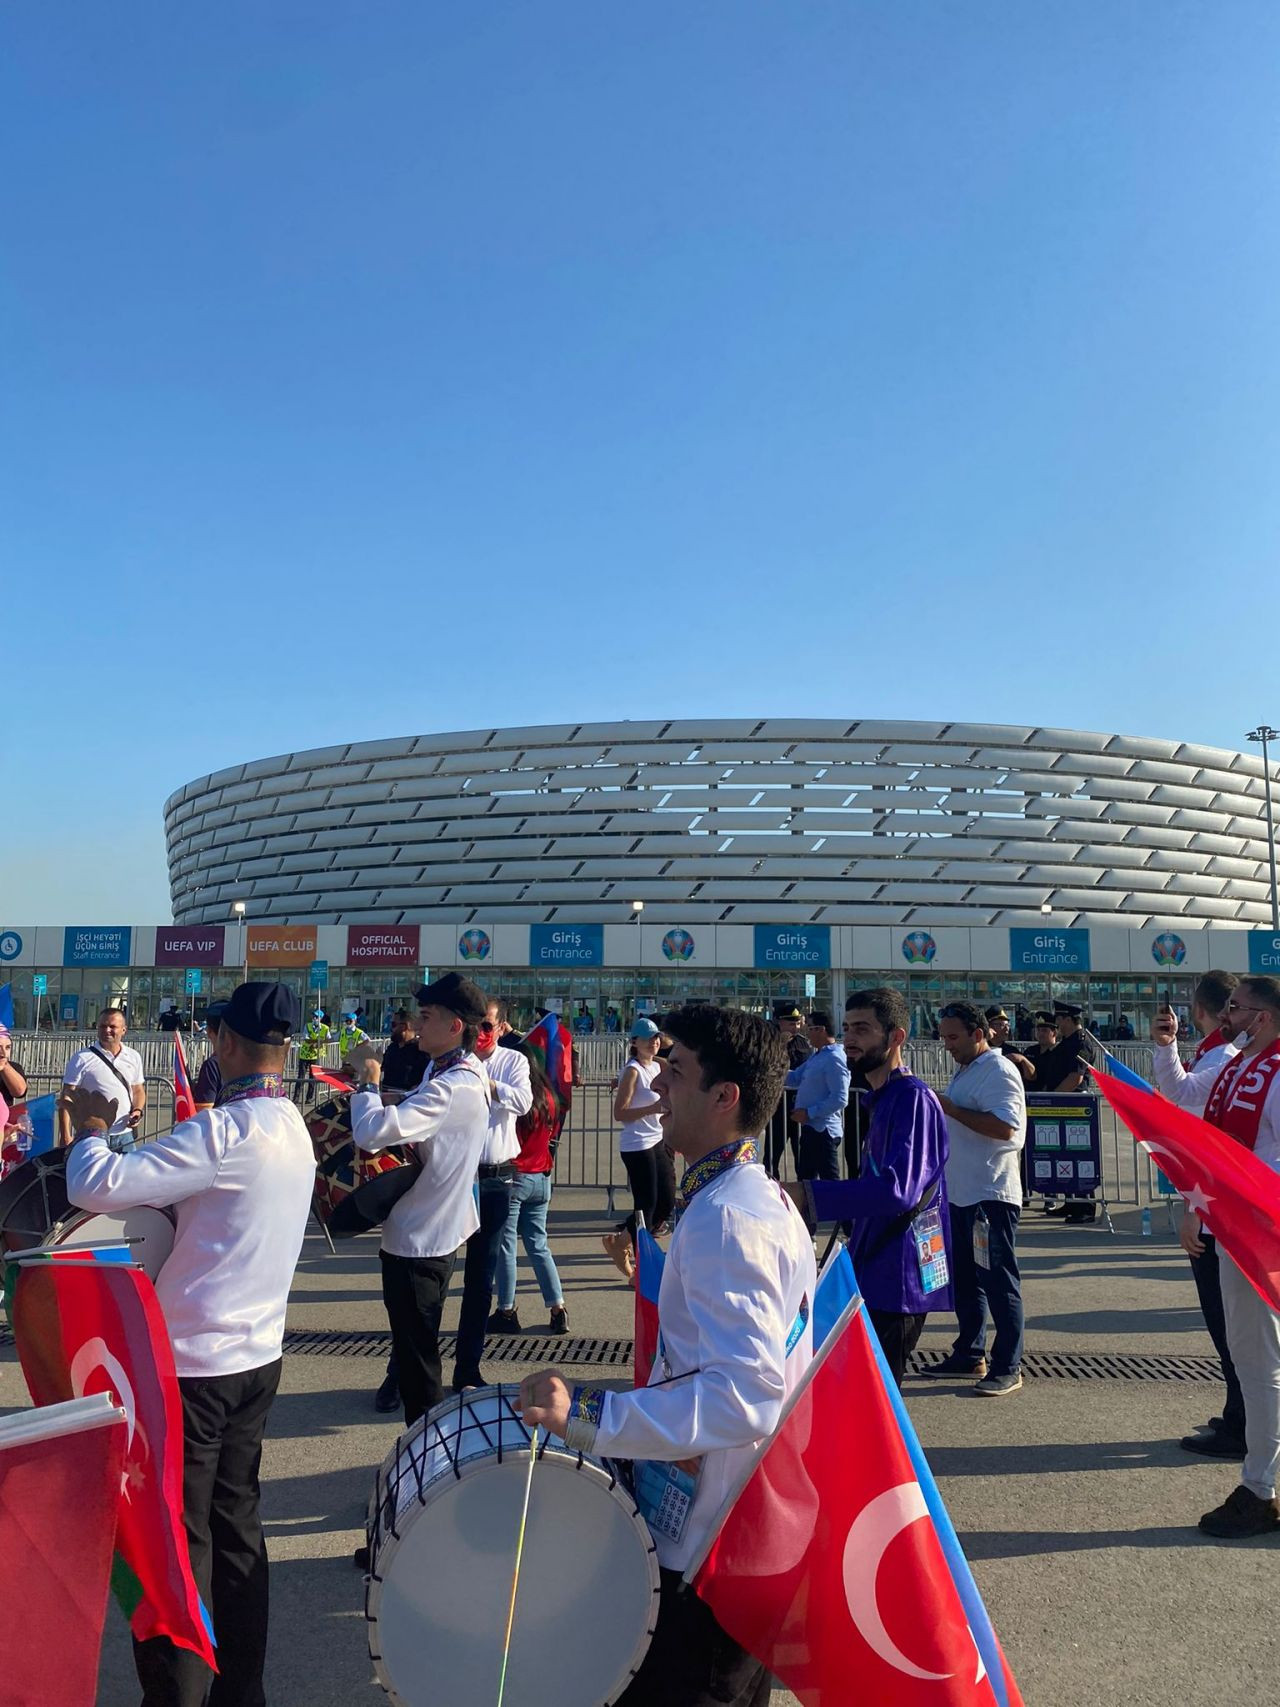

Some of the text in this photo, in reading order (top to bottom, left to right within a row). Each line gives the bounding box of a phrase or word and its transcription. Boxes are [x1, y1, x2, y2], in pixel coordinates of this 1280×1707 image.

[361, 935, 406, 945] OFFICIAL
[552, 932, 582, 947] Giriş
[776, 933, 808, 949] Giriş
[1034, 936, 1066, 951] Giriş
[164, 941, 216, 951] UEFA VIP
[249, 941, 314, 951] UEFA CLUB
[351, 946, 415, 956] HOSPITALITY
[90, 951, 120, 960] Entrance
[540, 947, 593, 959] Entrance
[766, 949, 820, 961] Entrance
[1022, 952, 1078, 964] Entrance
